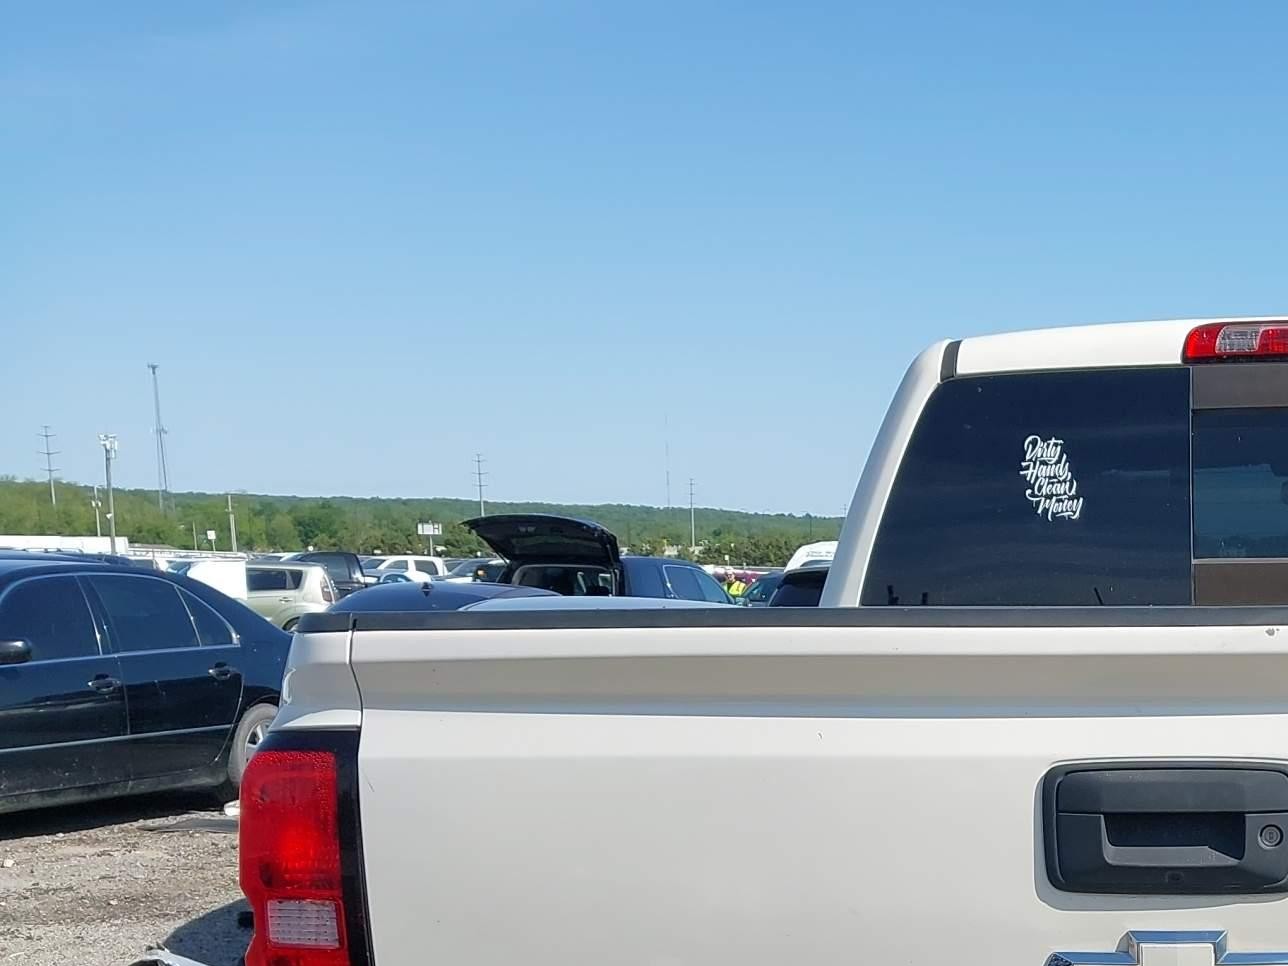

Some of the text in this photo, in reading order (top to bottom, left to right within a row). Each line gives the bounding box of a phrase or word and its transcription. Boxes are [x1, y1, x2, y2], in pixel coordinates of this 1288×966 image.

[1024, 434, 1064, 464] Dirty
[1034, 477, 1076, 497] Clean
[1025, 489, 1083, 522] Money
